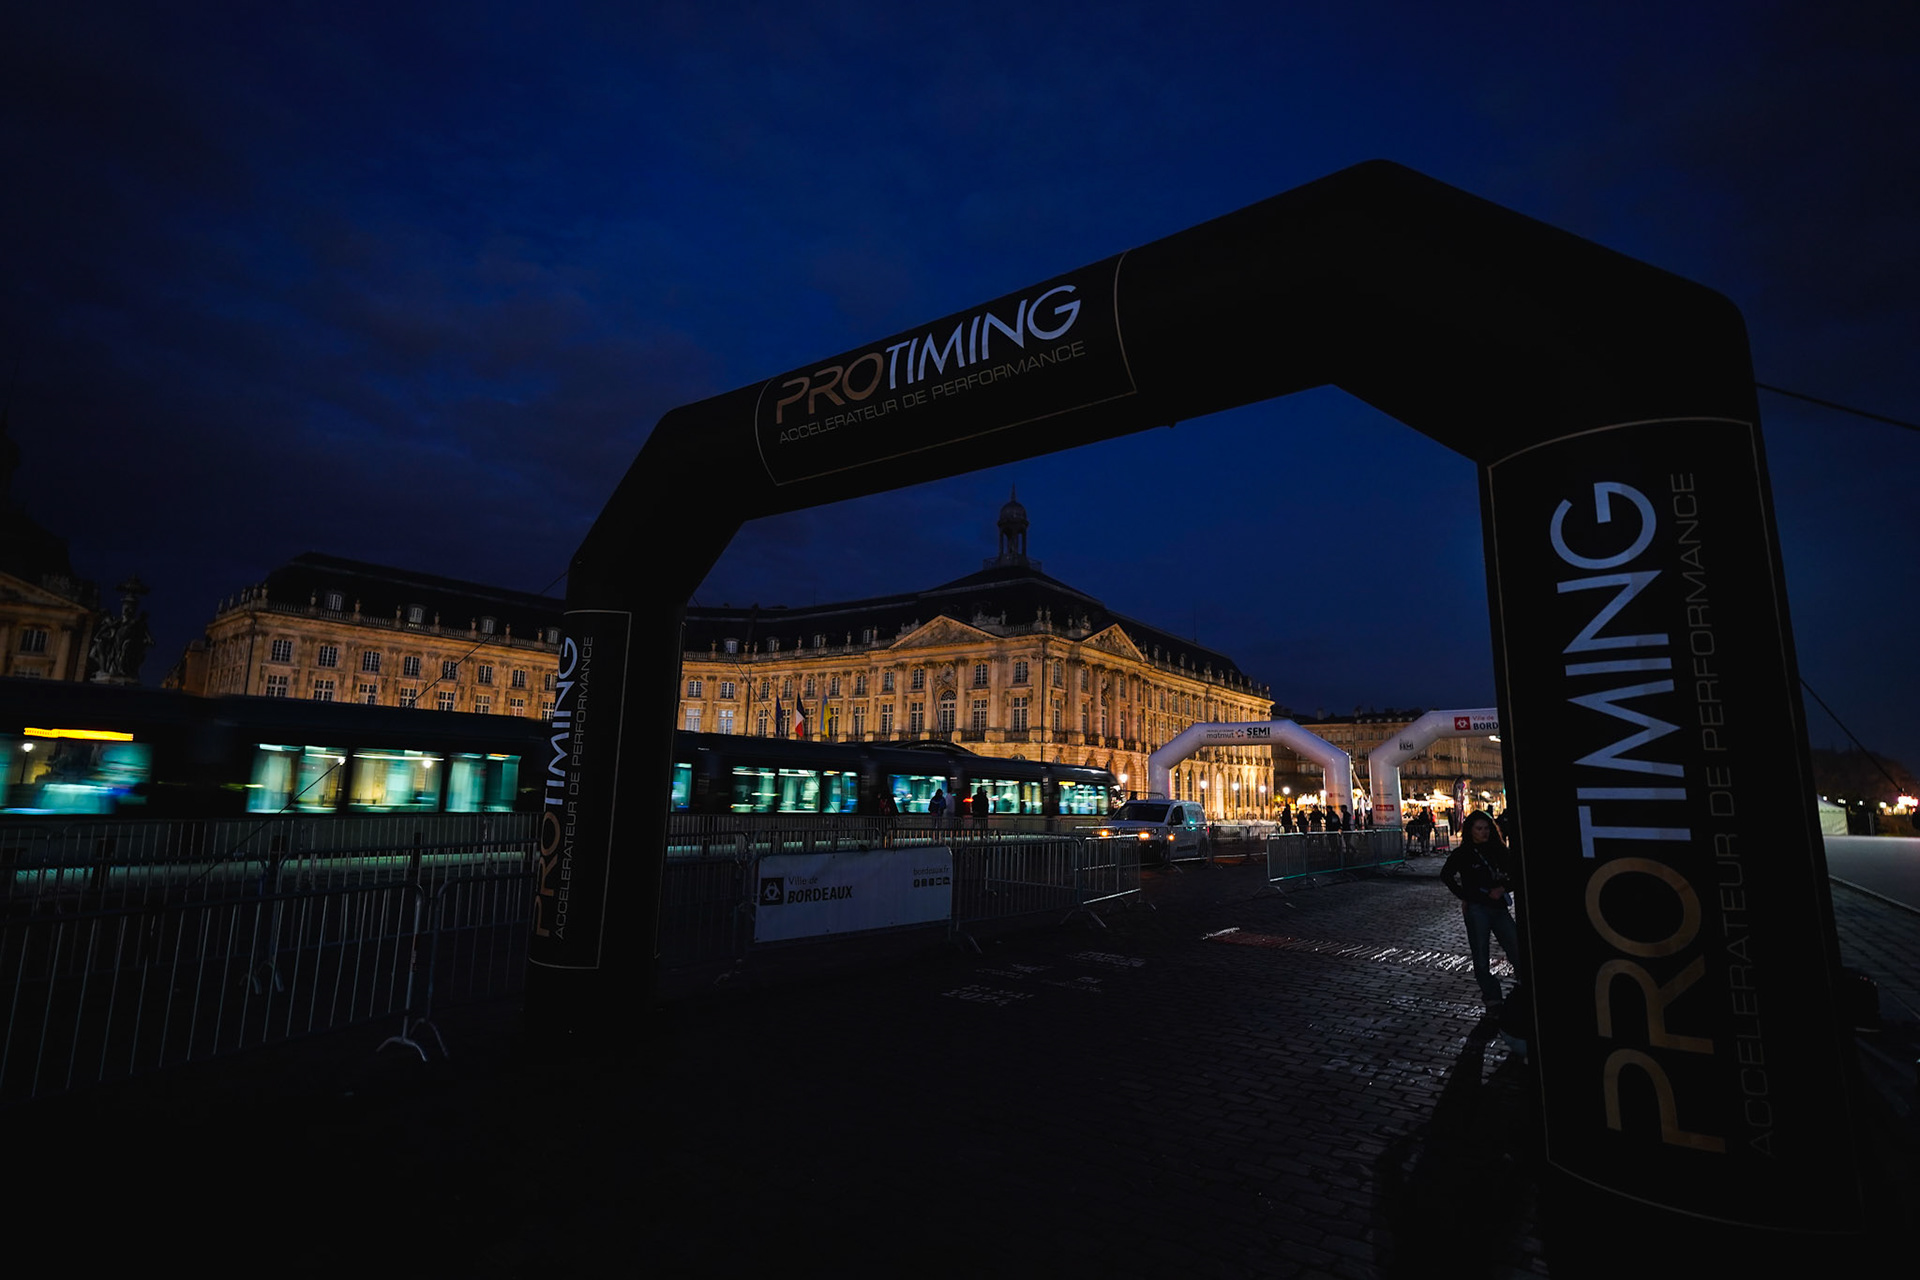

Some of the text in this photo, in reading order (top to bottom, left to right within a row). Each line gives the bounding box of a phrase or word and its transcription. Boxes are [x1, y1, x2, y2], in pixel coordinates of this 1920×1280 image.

[776, 284, 1081, 425] PROTIMING
[779, 340, 1087, 444] ACCELERATEUR DE PERFORMANCE
[532, 636, 578, 937] PROTIMING
[554, 636, 594, 940] ACCELERATEUR DE PERFORMANCE
[1246, 727, 1271, 736] SEMI
[788, 875, 819, 886] Ville de
[1550, 481, 1726, 1154] PROTIMING
[1670, 472, 1776, 1159] ACCELERATEUR DE PERFORMANCE
[787, 885, 853, 904] BORDEAUX
